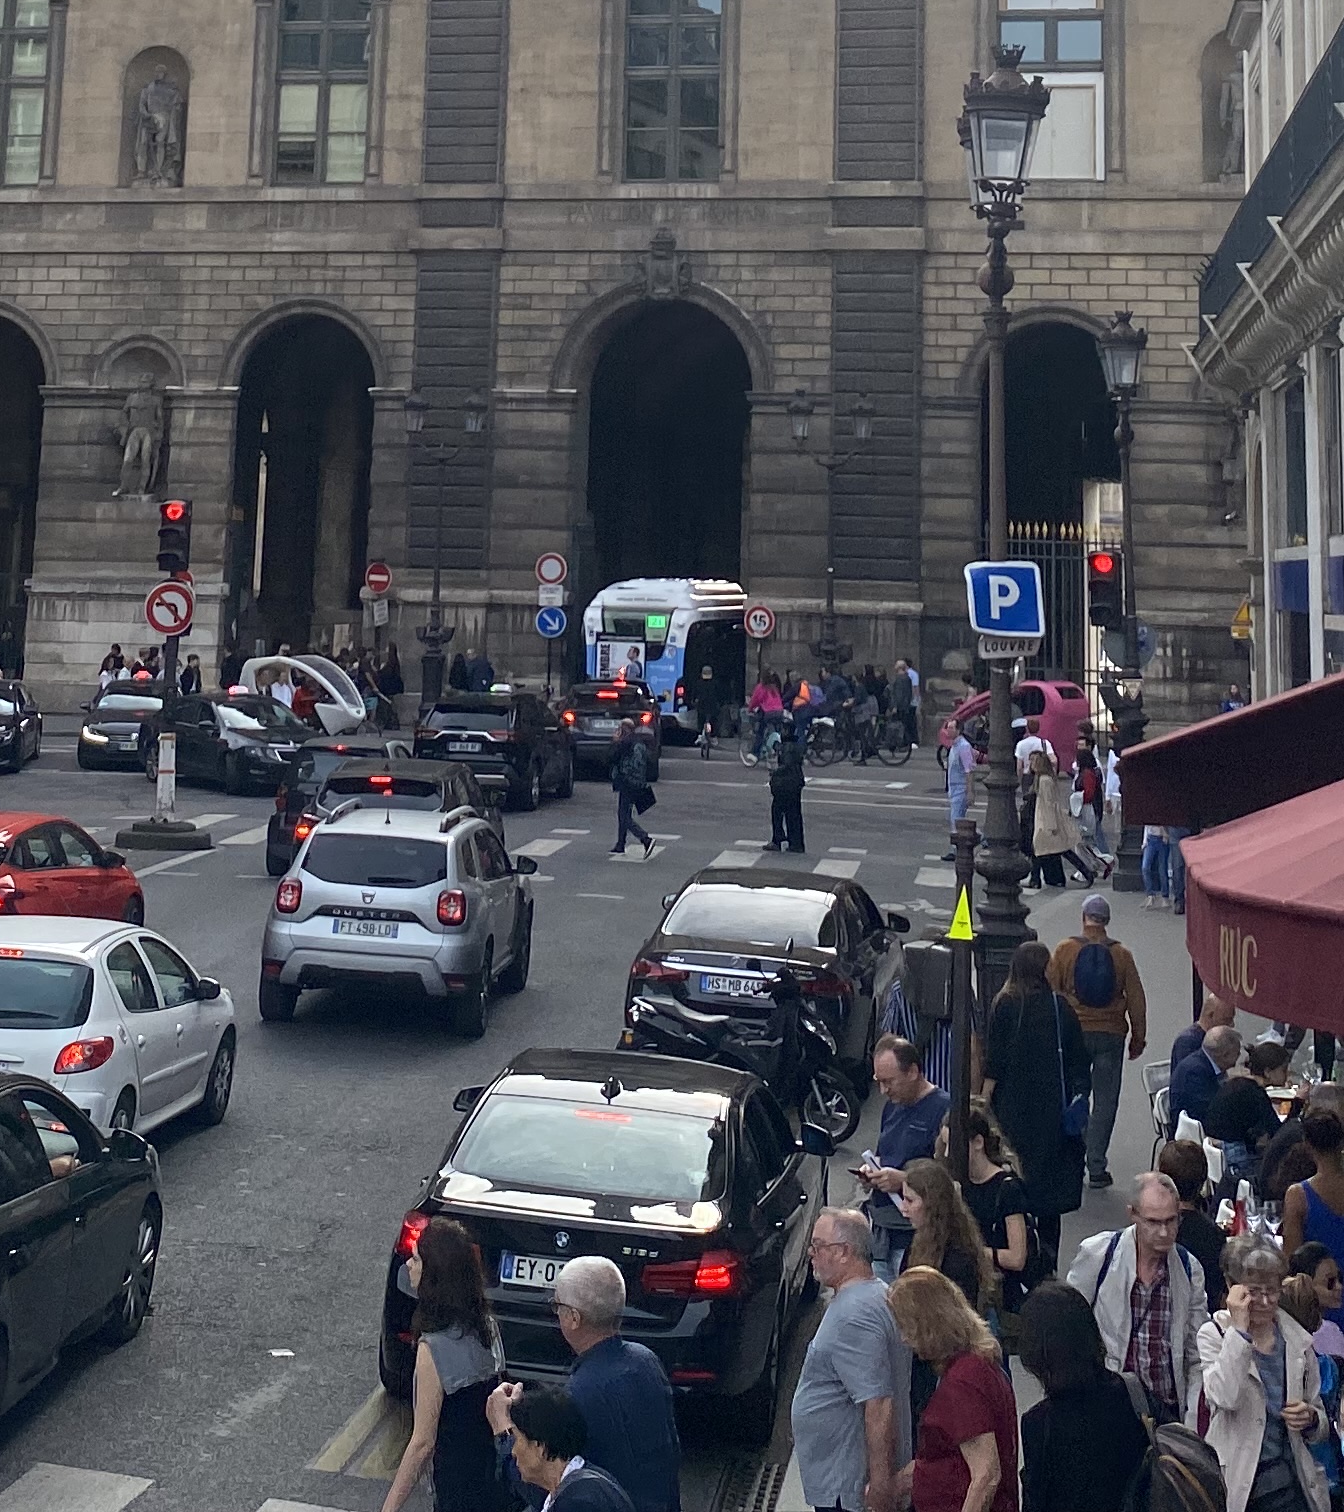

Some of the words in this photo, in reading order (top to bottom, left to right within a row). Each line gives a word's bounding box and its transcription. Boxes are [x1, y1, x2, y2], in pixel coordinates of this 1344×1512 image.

[988, 574, 1021, 620] P
[983, 639, 1035, 653] LOUVRE
[1219, 923, 1258, 999] RUC
[515, 1258, 565, 1283] EY-0
